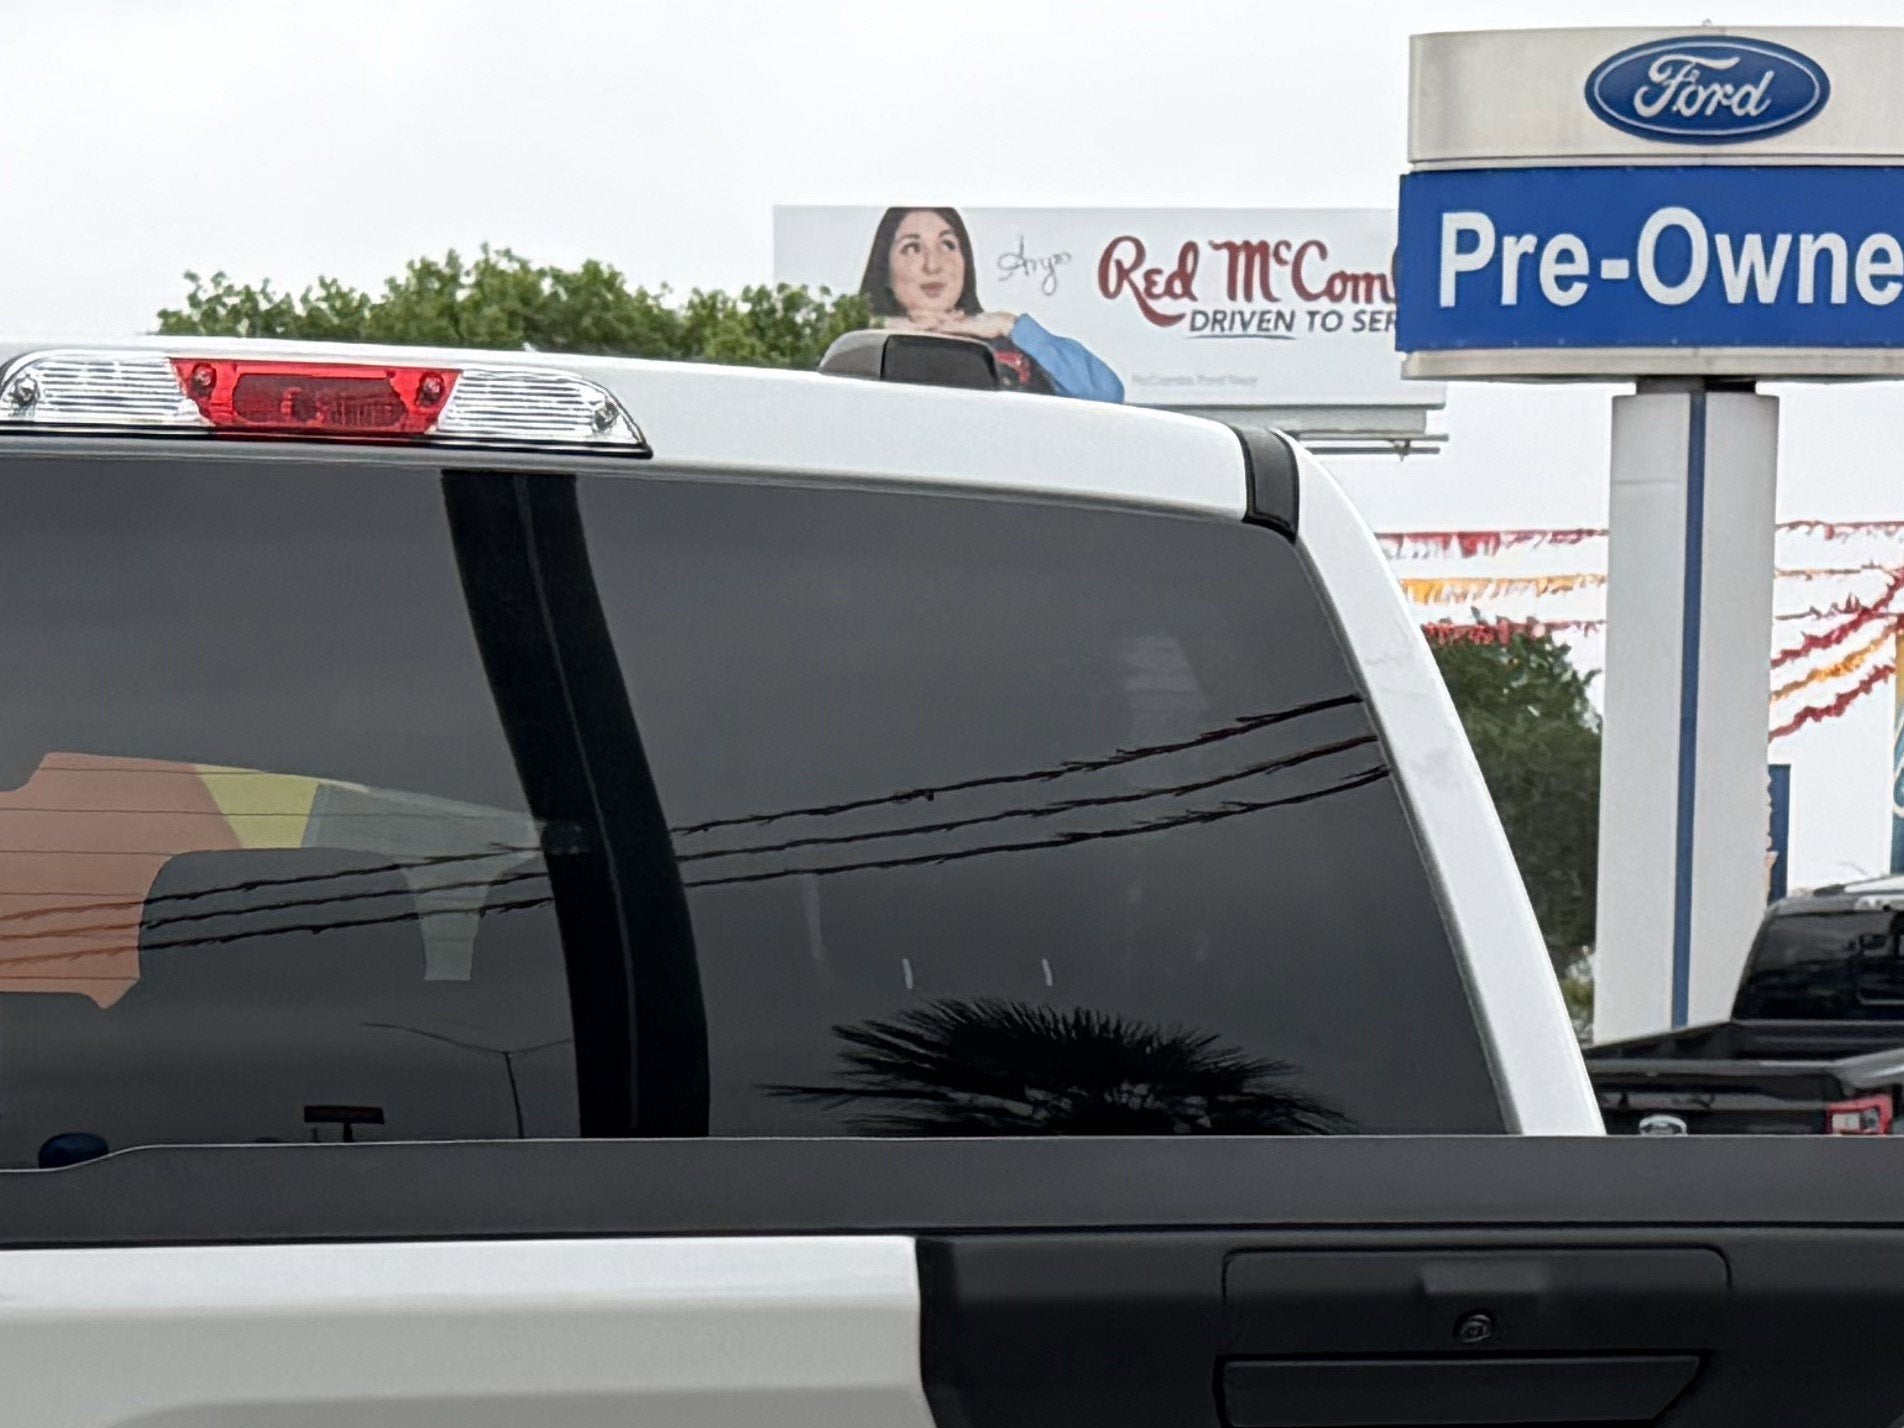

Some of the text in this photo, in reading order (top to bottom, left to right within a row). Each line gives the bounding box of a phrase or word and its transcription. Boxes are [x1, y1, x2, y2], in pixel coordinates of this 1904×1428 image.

[1633, 54, 1774, 118] Ford
[1098, 235, 1196, 327] Red
[1209, 239, 1398, 304] McCom
[1189, 309, 1295, 333] DRIVEN
[1307, 309, 1344, 333] TO
